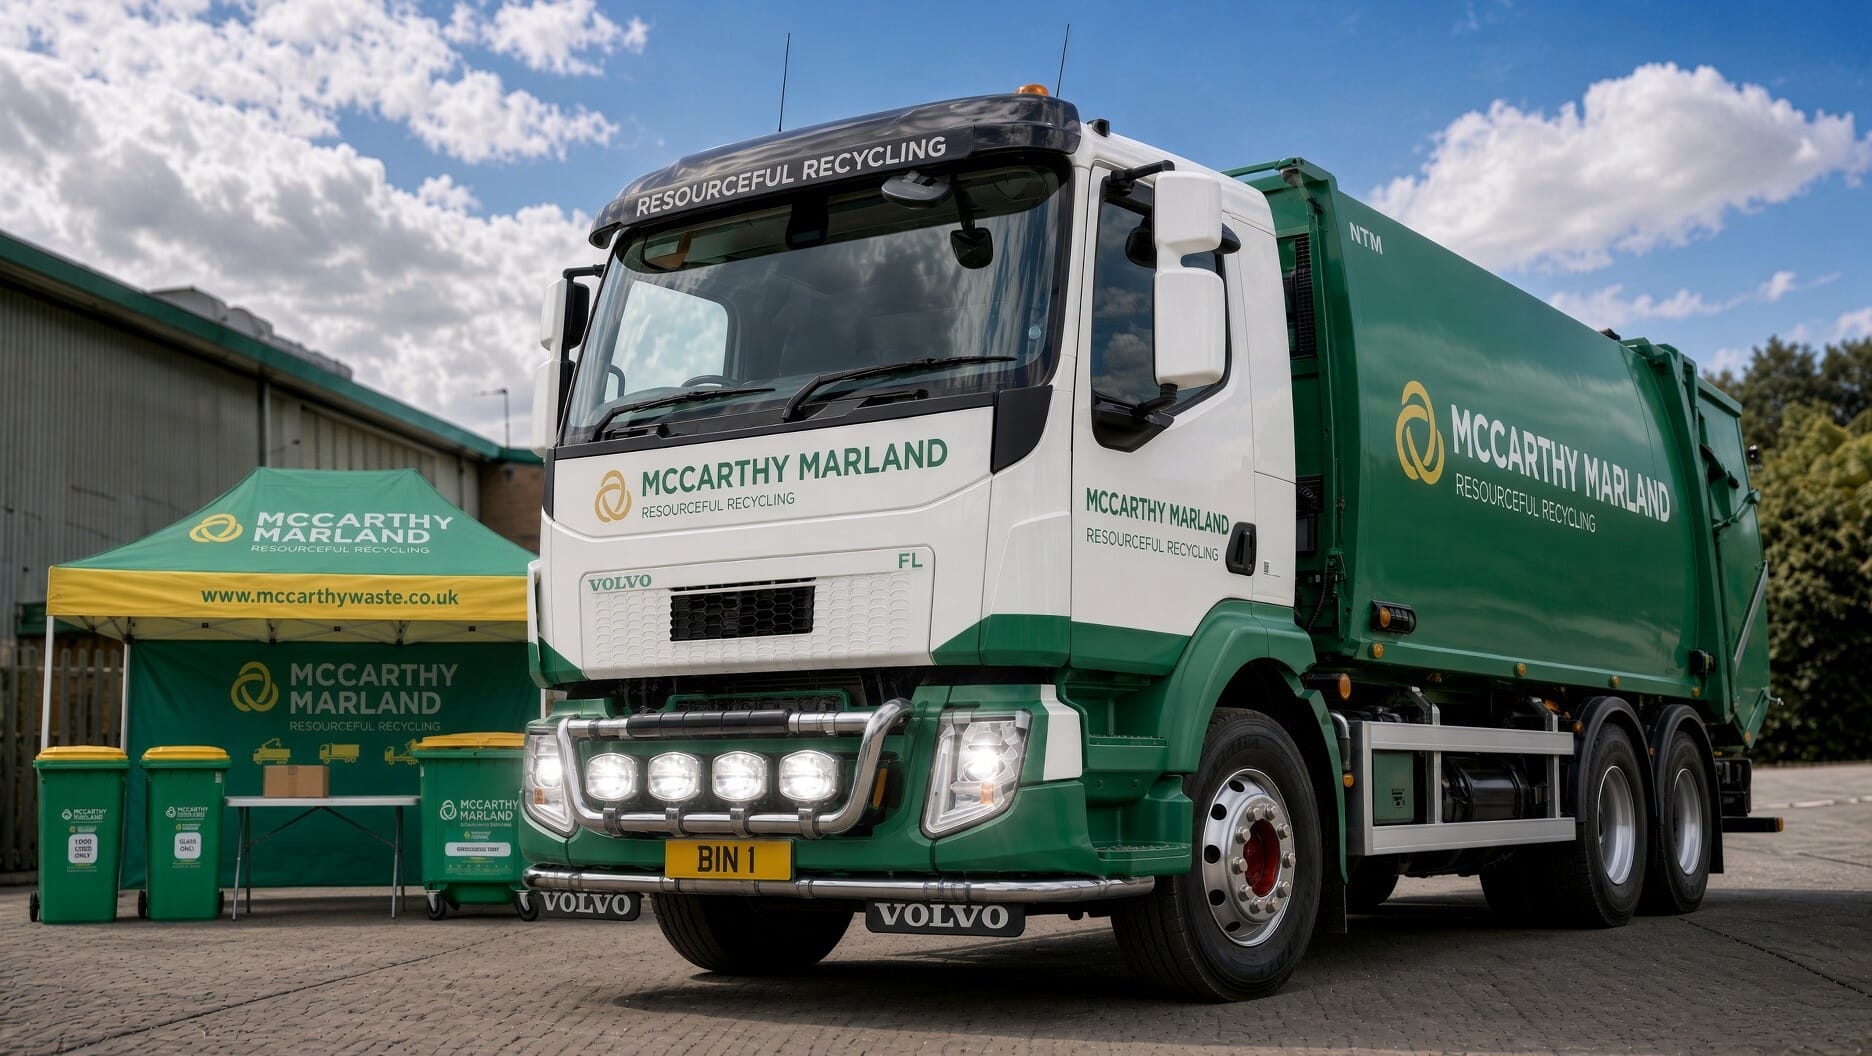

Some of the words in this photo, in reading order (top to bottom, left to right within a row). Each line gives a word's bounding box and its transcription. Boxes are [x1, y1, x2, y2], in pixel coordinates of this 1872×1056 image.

[636, 164, 795, 217] RESOURCEFUL
[802, 136, 947, 180] RECYCLING
[1350, 221, 1383, 255] NTM
[641, 455, 790, 497] MCCARTHY
[799, 438, 949, 480] MARLAND
[1451, 404, 1578, 492] MCCARTHY
[1584, 453, 1671, 523] MARLAND
[641, 498, 724, 519] RESOURCEFUL
[727, 491, 796, 511] RECYCLING
[1086, 487, 1166, 524] MCCARTHY
[1169, 503, 1229, 536] MARLAND
[1456, 473, 1539, 518] RESOURCEFUL
[1542, 499, 1597, 533] RECYCLING
[257, 512, 454, 530] MCCARTHY
[253, 527, 431, 544] MARLAND
[1086, 527, 1165, 553] RESOURCEFUL
[1167, 540, 1219, 561] RECYCLING
[251, 545, 350, 553] RESOURCEFUL
[354, 546, 431, 554] RECYCLING
[898, 552, 923, 569] FL
[588, 574, 653, 592] VOLVO
[201, 587, 460, 608] www.mccarthywaste.co.uk
[290, 663, 458, 687] MCCARTHY
[290, 690, 441, 715] MARLAND
[289, 721, 375, 732] RESOURCEFUL
[378, 721, 441, 732] RECYCLING
[460, 799, 519, 810] MCCARTHY
[460, 810, 513, 821] MARLAND
[697, 845, 738, 873] BIN
[748, 846, 755, 874] 1
[540, 892, 632, 915] VOLVO
[874, 903, 1009, 929] VOLVO
